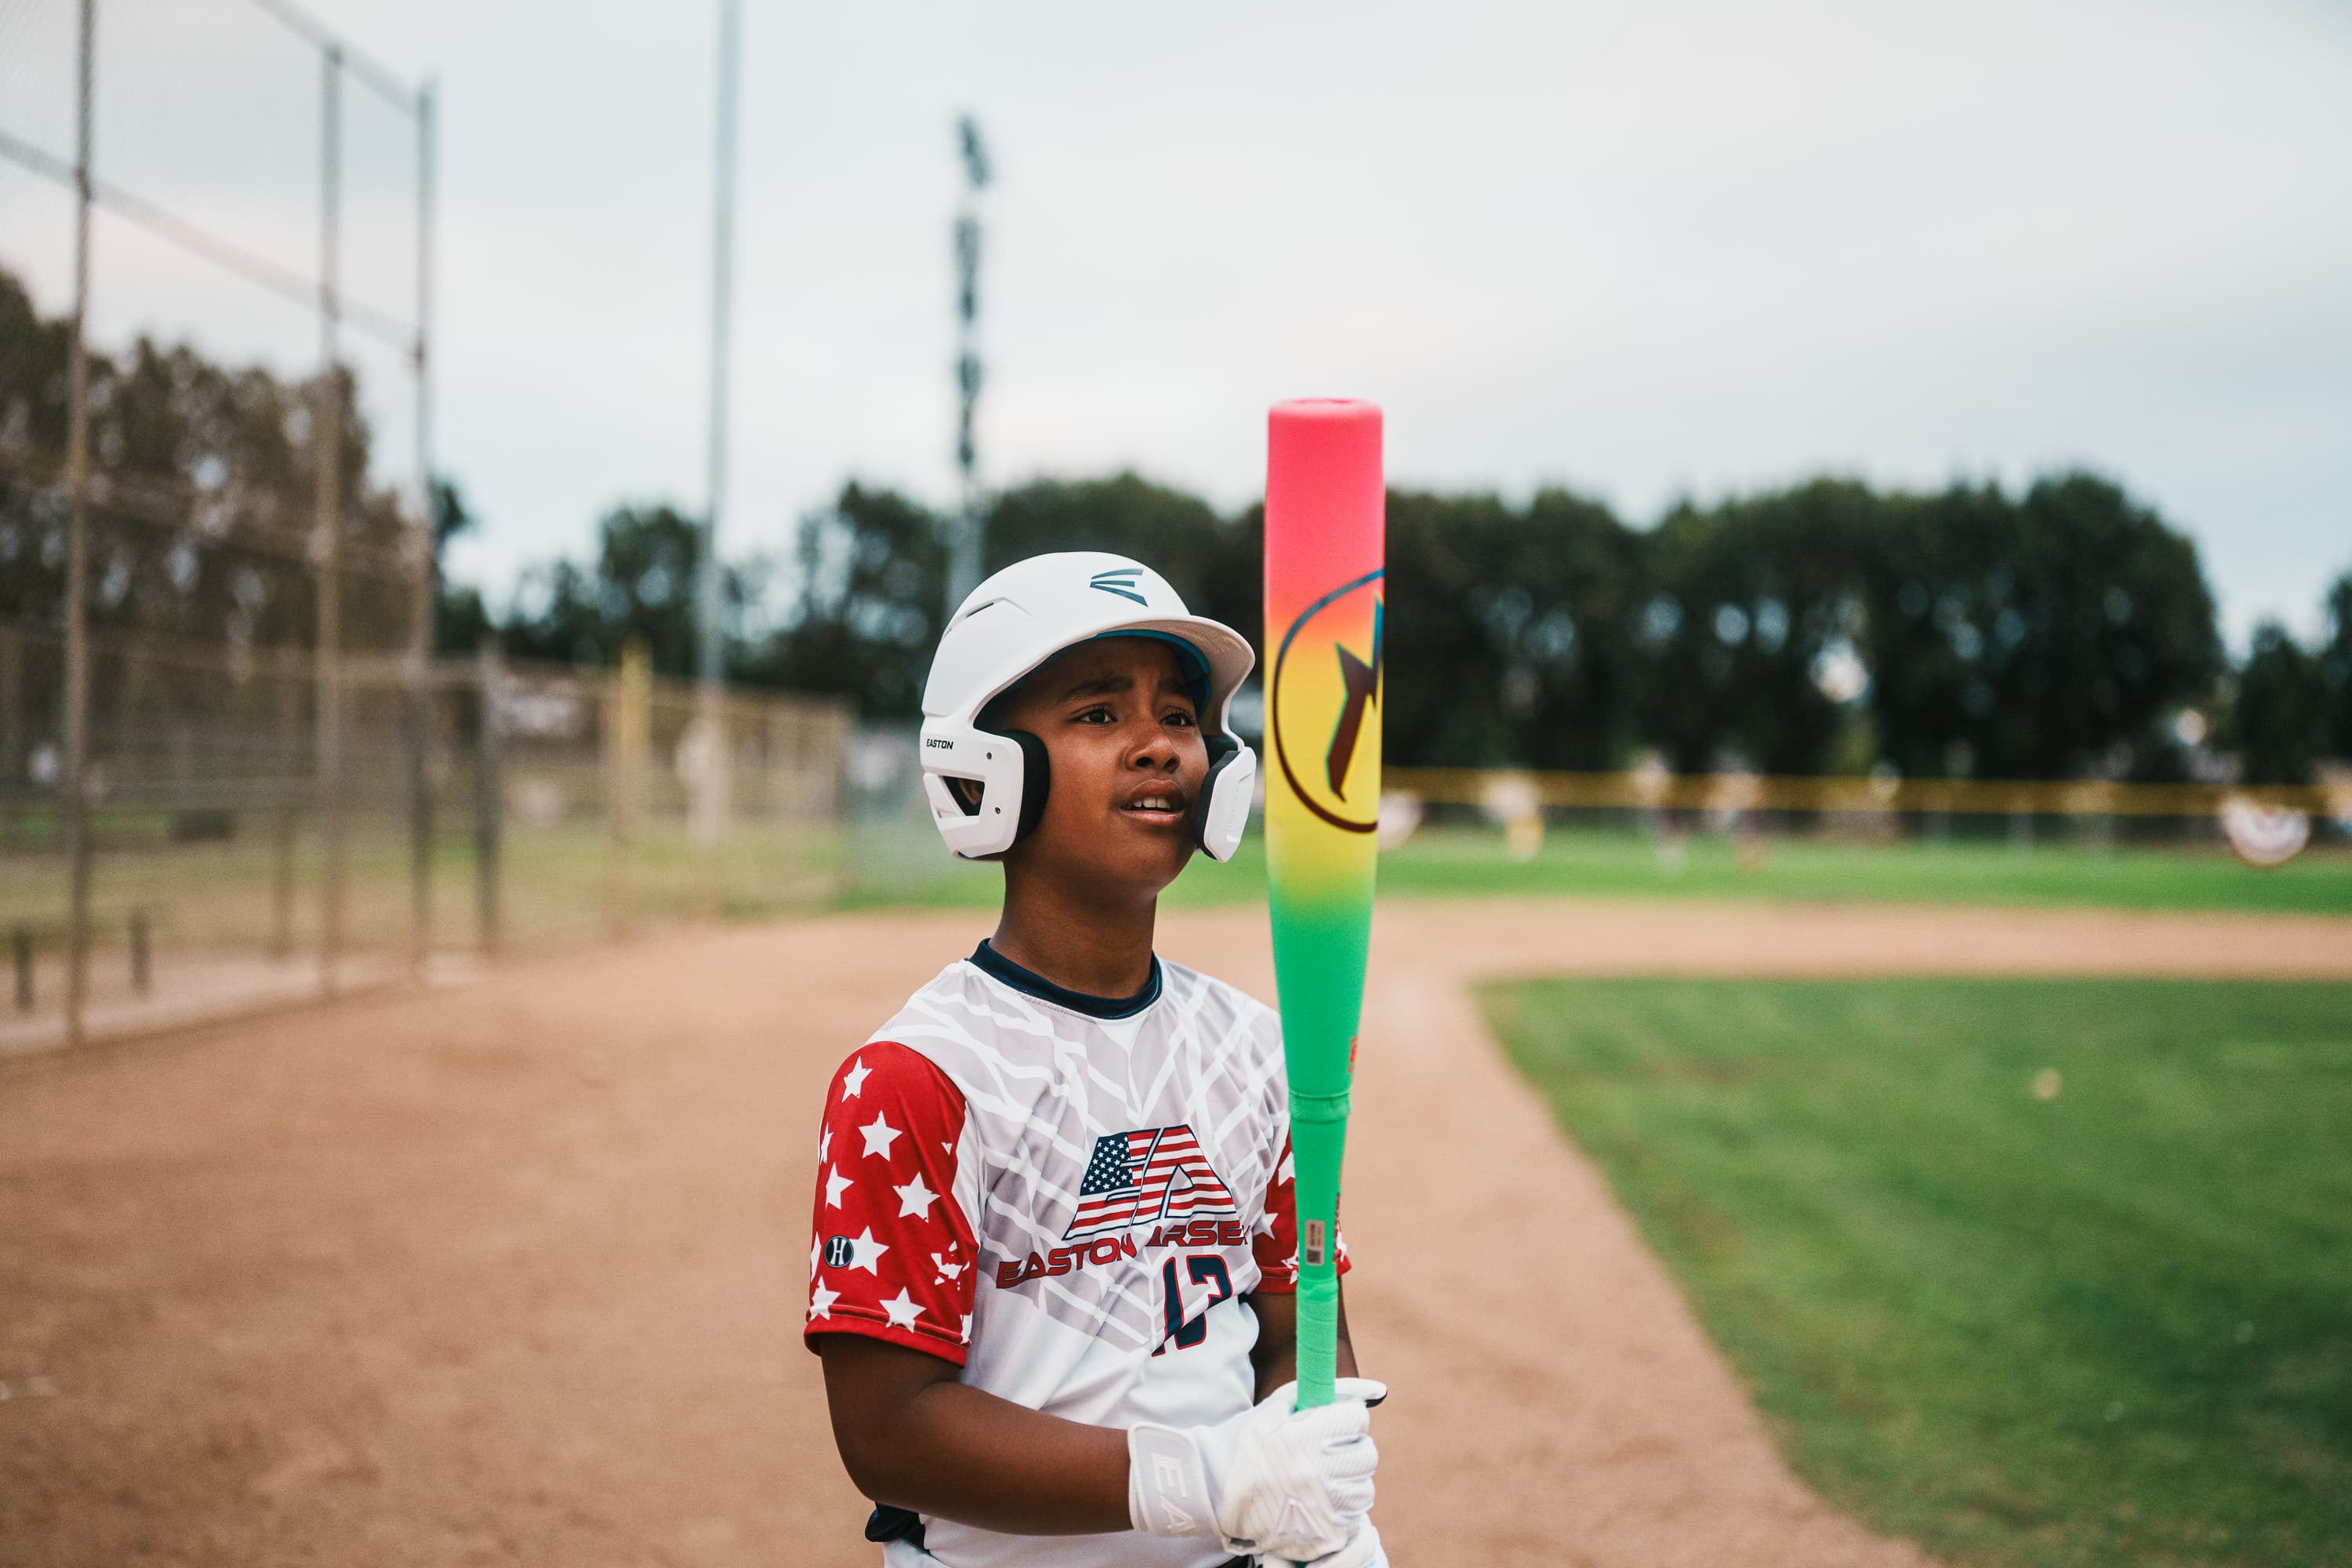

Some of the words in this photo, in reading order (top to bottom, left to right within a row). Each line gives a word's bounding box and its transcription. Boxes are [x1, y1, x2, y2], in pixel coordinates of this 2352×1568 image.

[926, 738, 954, 750] EASTON
[996, 1233, 1138, 1290] EASTON
[1150, 1453, 1196, 1535] EA
